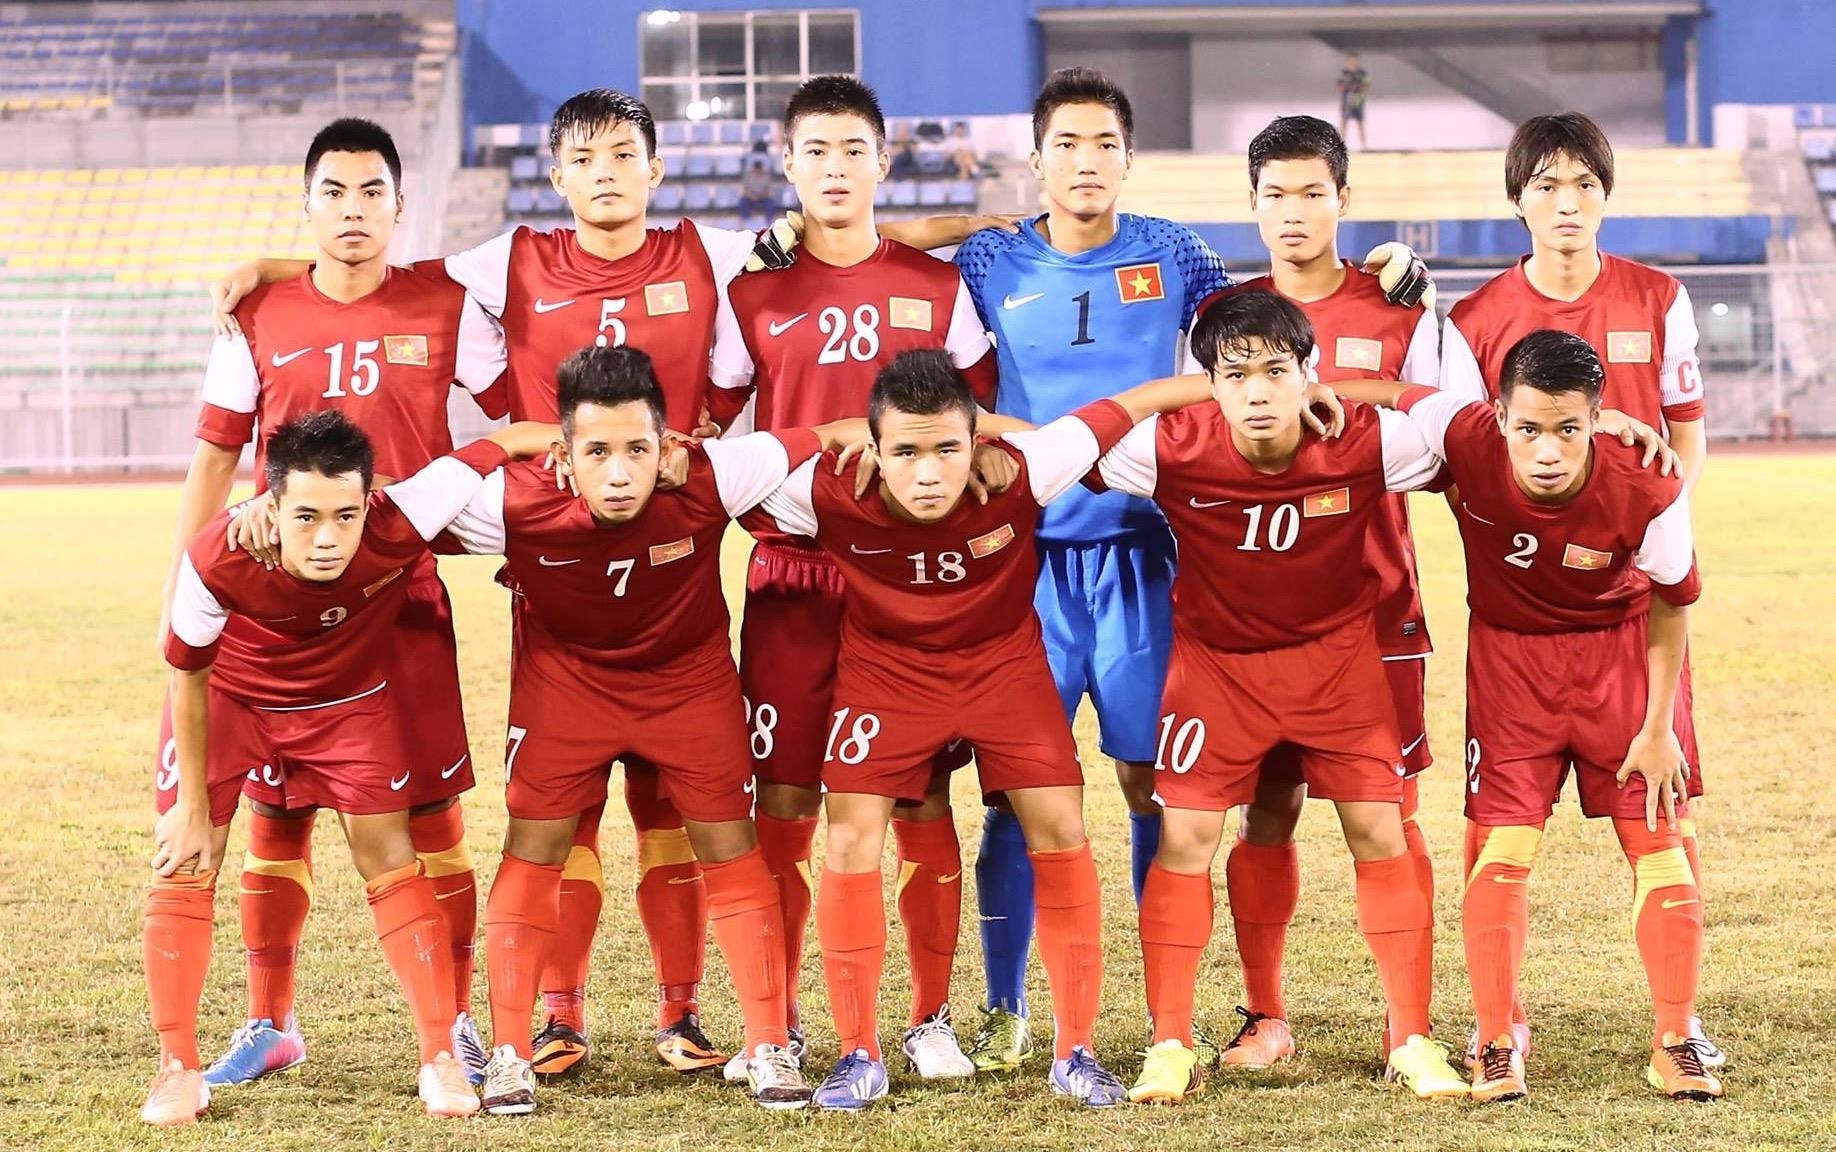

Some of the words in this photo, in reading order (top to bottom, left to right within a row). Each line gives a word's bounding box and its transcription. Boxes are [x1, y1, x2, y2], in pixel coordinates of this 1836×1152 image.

[595, 297, 626, 349] 5
[817, 303, 880, 365] 28
[1071, 290, 1095, 346] 1
[322, 339, 380, 398] 15
[1677, 360, 1696, 394] C
[1236, 503, 1300, 552] 10
[1503, 532, 1539, 569] 2
[606, 558, 636, 597] 7
[907, 551, 967, 584] 18
[320, 606, 348, 627] 9
[506, 725, 527, 784] 7
[823, 706, 881, 765] 18
[1154, 712, 1206, 774] 10
[157, 736, 180, 791] 9
[1467, 737, 1481, 794] 2
